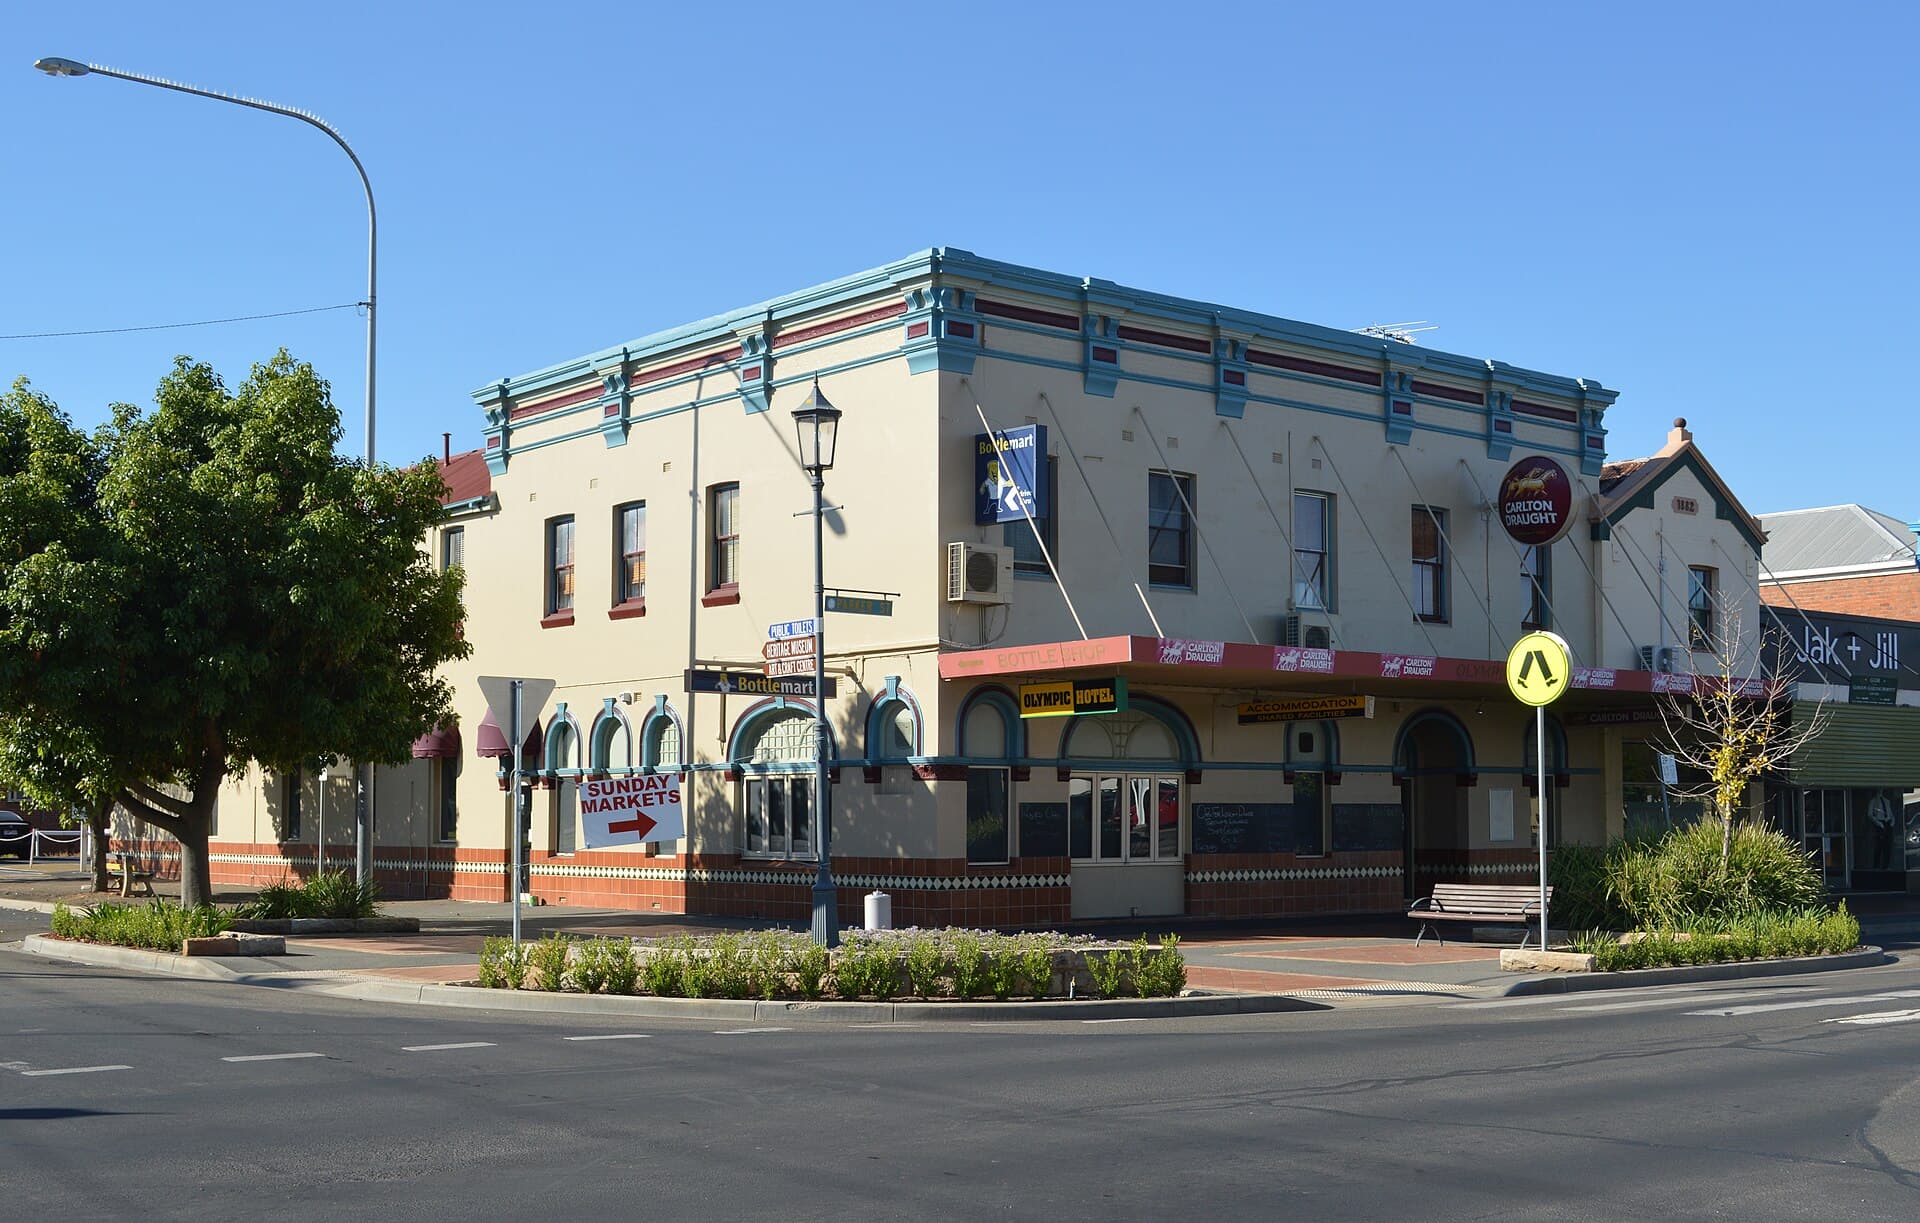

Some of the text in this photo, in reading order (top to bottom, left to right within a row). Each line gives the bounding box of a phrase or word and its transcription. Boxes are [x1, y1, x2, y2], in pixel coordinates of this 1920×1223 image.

[1505, 500, 1553, 514] CARLTON
[1505, 512, 1558, 527] DRAUGHT
[771, 620, 813, 638] PUBLIC TOILETS
[766, 638, 813, 658] HERITAGE MUSEUM
[1188, 643, 1220, 654] CARLTON
[1797, 626, 1839, 665] Jak
[1869, 632, 1898, 670] Jill
[997, 644, 1105, 668] BOTTLE SHOP
[1185, 651, 1221, 663] DRAUGHT
[1302, 651, 1331, 662] CARLTON
[1405, 658, 1433, 668] CARLTON
[782, 660, 796, 674] CRAFT
[796, 659, 815, 673] CENTRE
[1300, 659, 1332, 670] DRAUGHT
[1403, 666, 1433, 676] DRAUGHT
[1591, 670, 1614, 679] CARLTON
[738, 677, 814, 694] Bottlemart
[1023, 687, 1114, 708] OLYMPIC HOTEL
[1247, 698, 1358, 713] ACCOMMODATION
[1256, 710, 1346, 721] SHARED FACILITIES
[588, 774, 670, 797] SUNDAY
[580, 789, 681, 814] MARKETS
